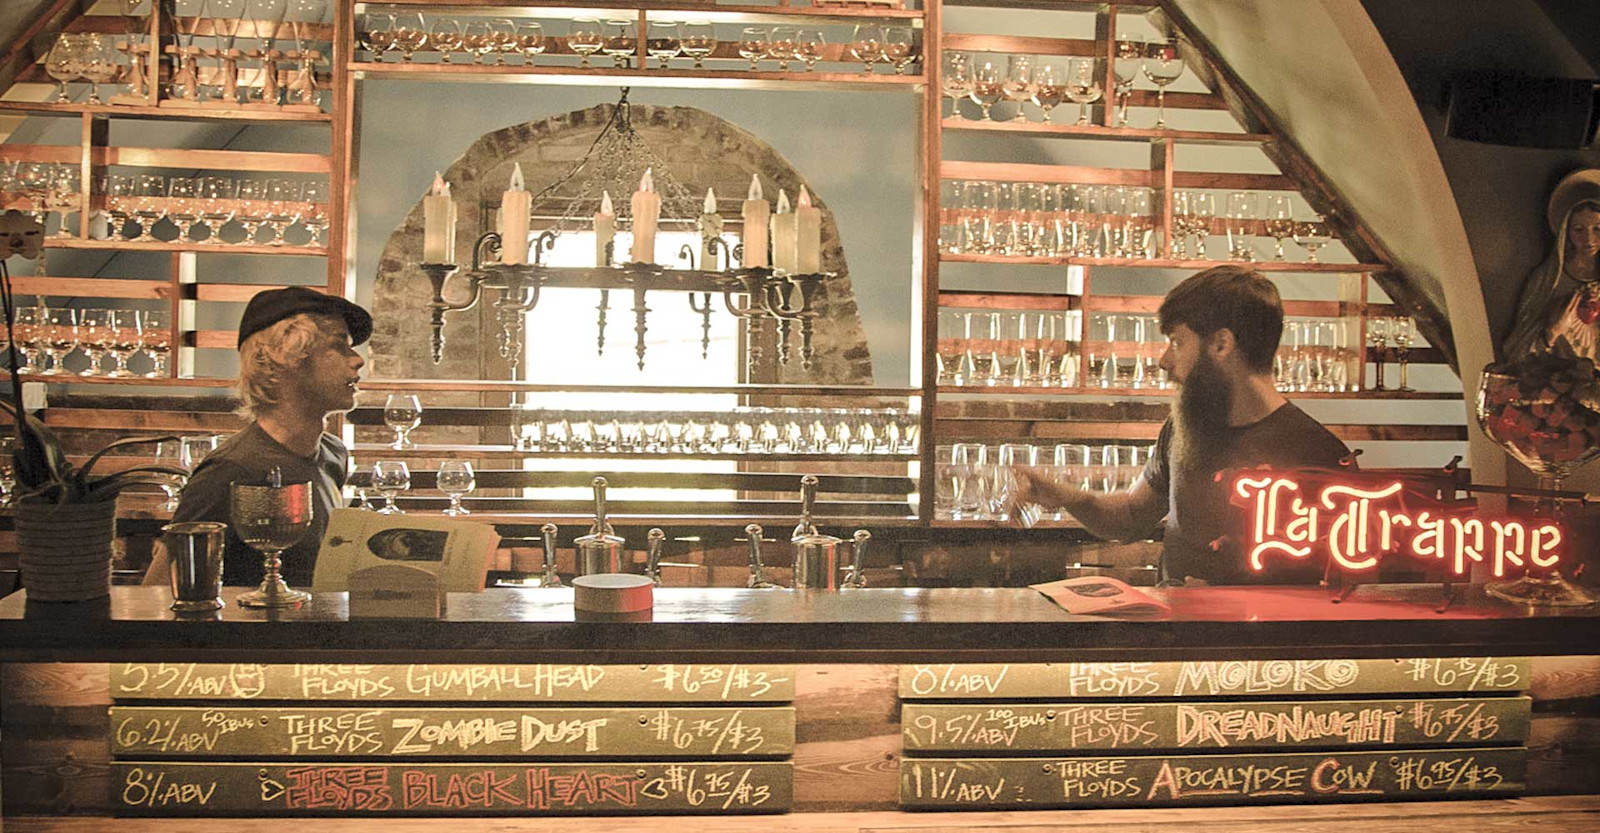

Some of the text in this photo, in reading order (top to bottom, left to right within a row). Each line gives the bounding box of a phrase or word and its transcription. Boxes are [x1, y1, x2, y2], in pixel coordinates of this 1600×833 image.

[1234, 476, 1562, 577] La Trappe
[302, 676, 395, 699] FLOYDS
[1070, 672, 1160, 696] FLOYDS
[1173, 660, 1359, 695] MOLOKO
[279, 710, 383, 735] THREE
[1055, 706, 1147, 726] THREE
[1177, 705, 1399, 748] DREADNAUGHT
[290, 732, 383, 754] FLOYDS
[391, 715, 607, 754] ZOMBIE DUST
[1071, 721, 1160, 748] FLOYDS
[286, 766, 390, 789] THREE
[1055, 759, 1127, 779] THREE
[1147, 759, 1309, 800] APOCALYPSE
[286, 786, 393, 811] FLOYDS
[402, 767, 645, 810] BLACK HEART
[1063, 777, 1142, 799] FLOYDS
